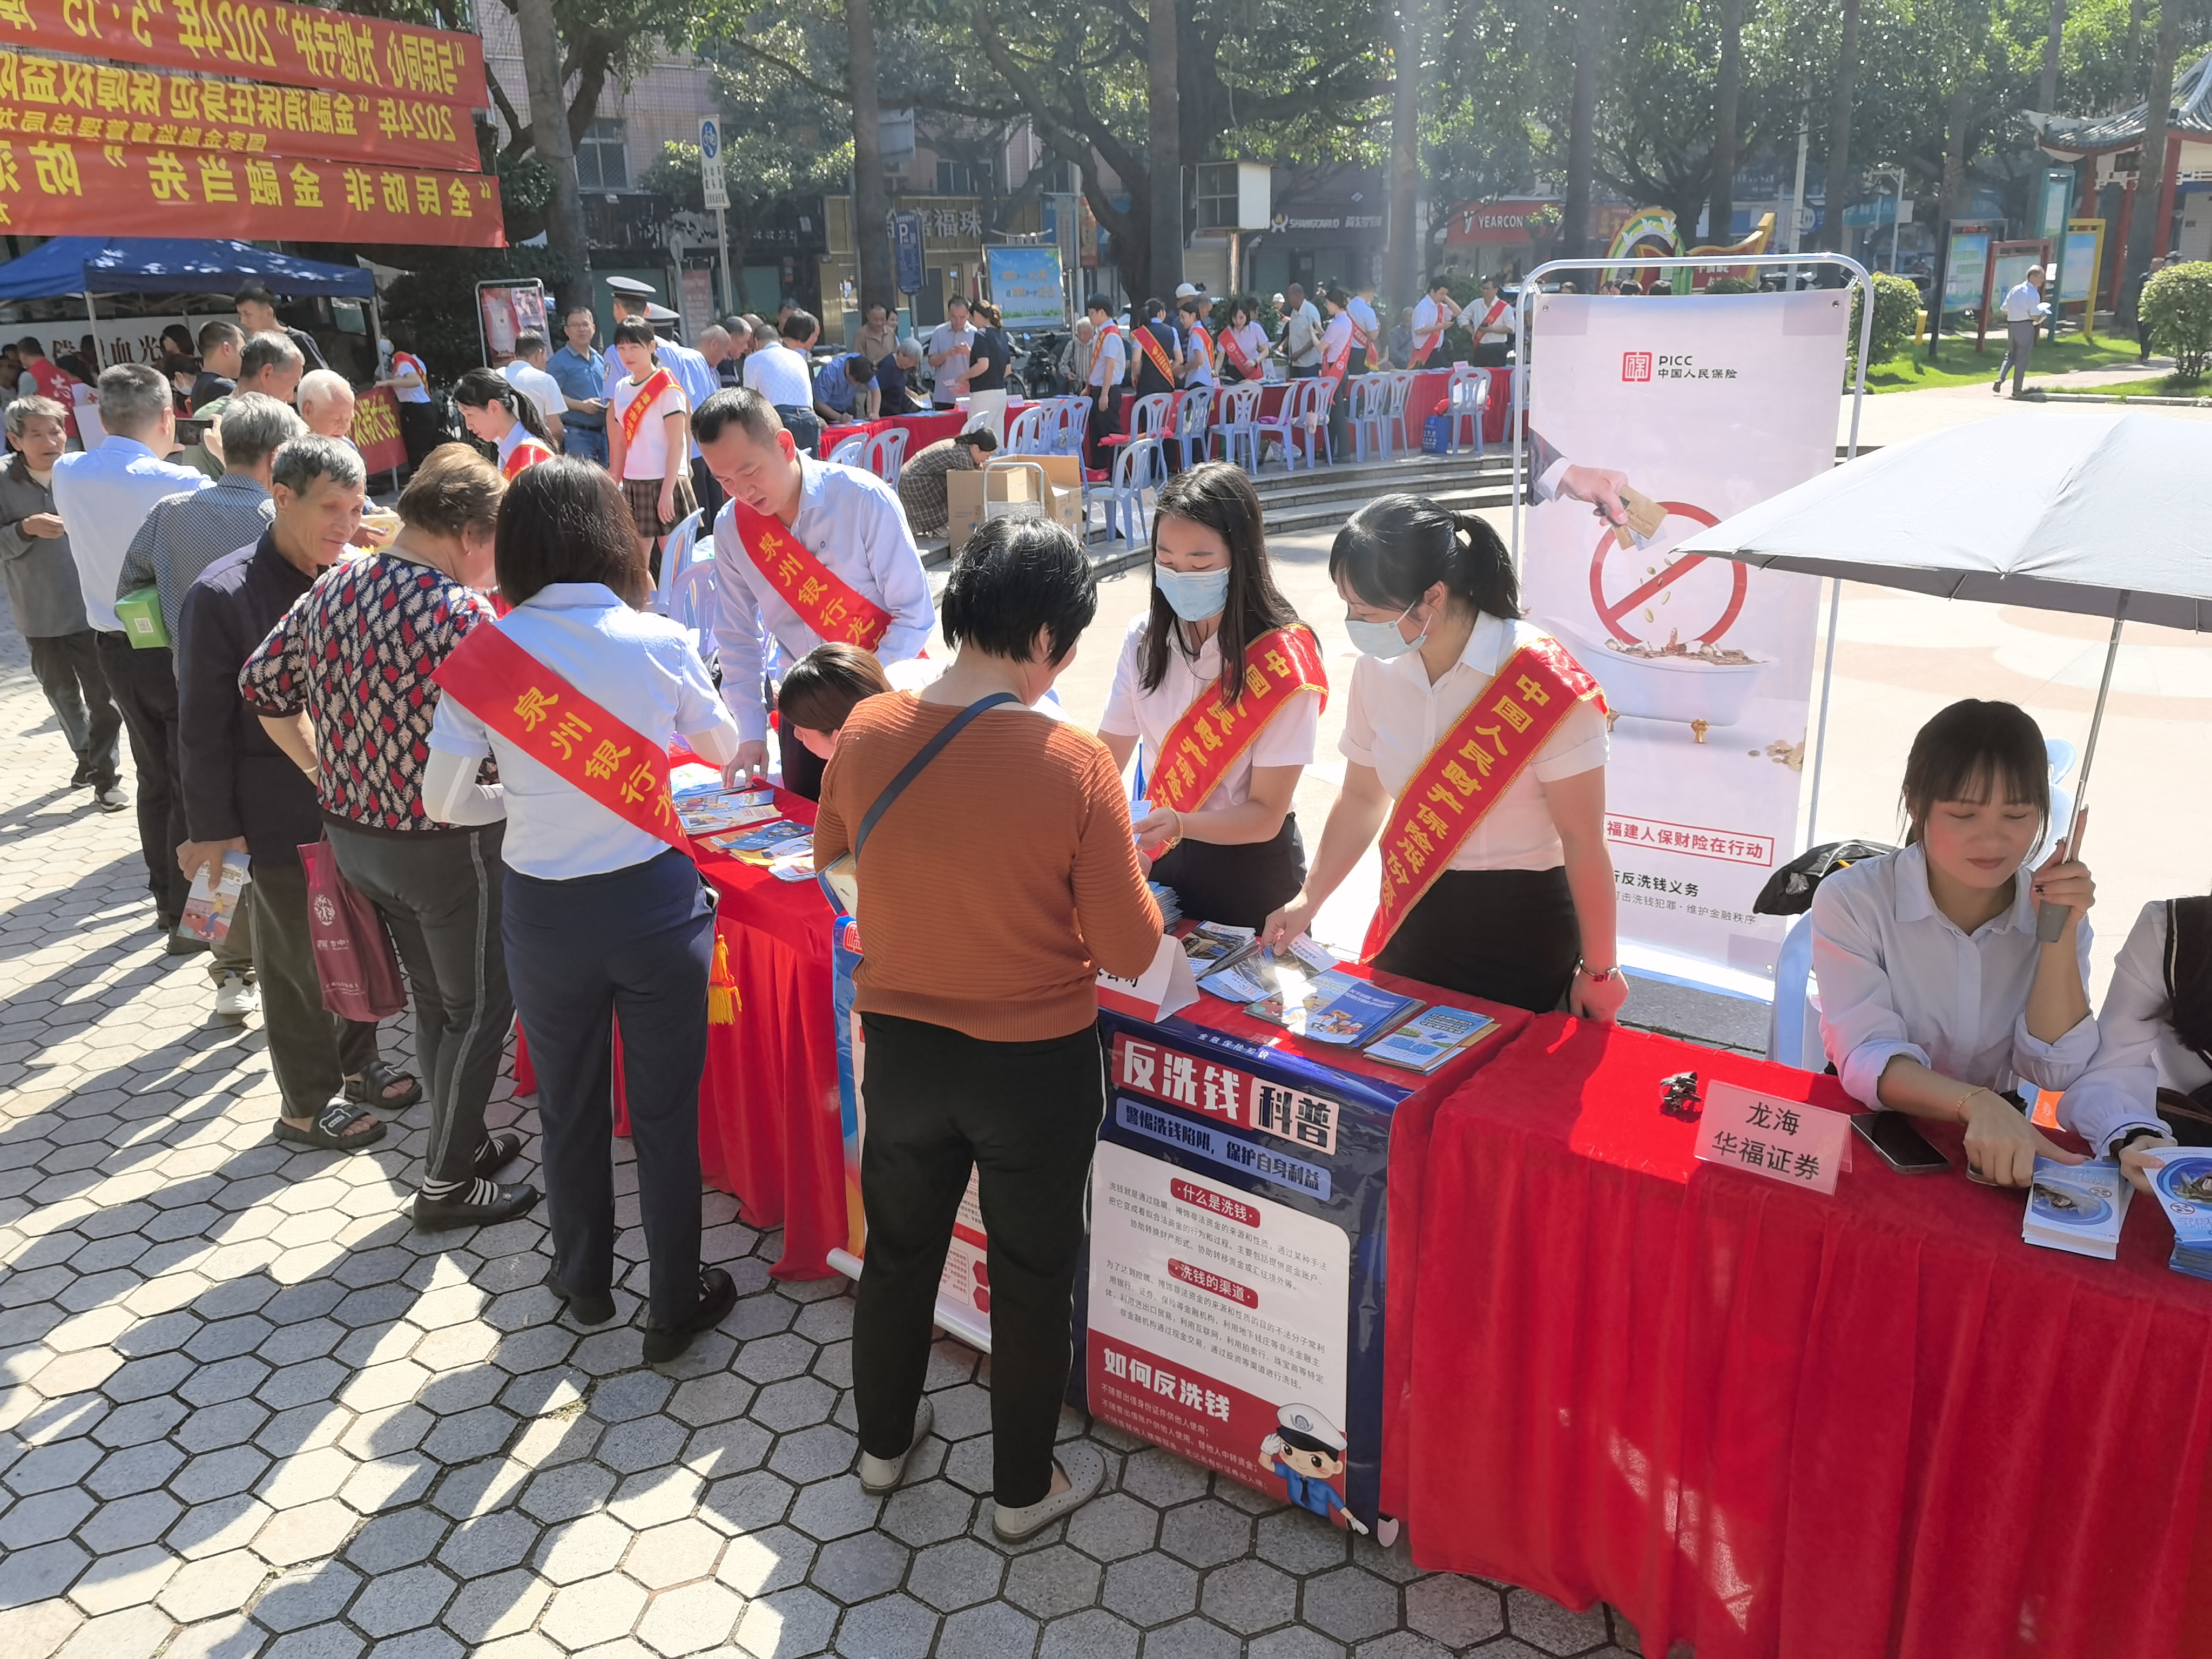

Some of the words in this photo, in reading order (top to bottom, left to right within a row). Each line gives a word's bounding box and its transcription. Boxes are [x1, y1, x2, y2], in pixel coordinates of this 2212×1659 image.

[899, 223, 909, 245] P
[1478, 215, 1523, 229] YEARCON
[1657, 367, 1738, 380] 中国人民保险
[1658, 355, 1693, 366] PICC
[759, 532, 885, 653] 泉州银行龙
[513, 686, 689, 839] 泉州银行龙
[1607, 820, 1764, 860] 福建人保财险在行动
[1123, 1040, 1240, 1121] 反洗钱
[1258, 1085, 1331, 1149] 科普
[1744, 1100, 1802, 1137] 龙海
[1711, 1130, 1821, 1182] 华福证券
[1103, 1347, 1231, 1423] 如何反洗钱
